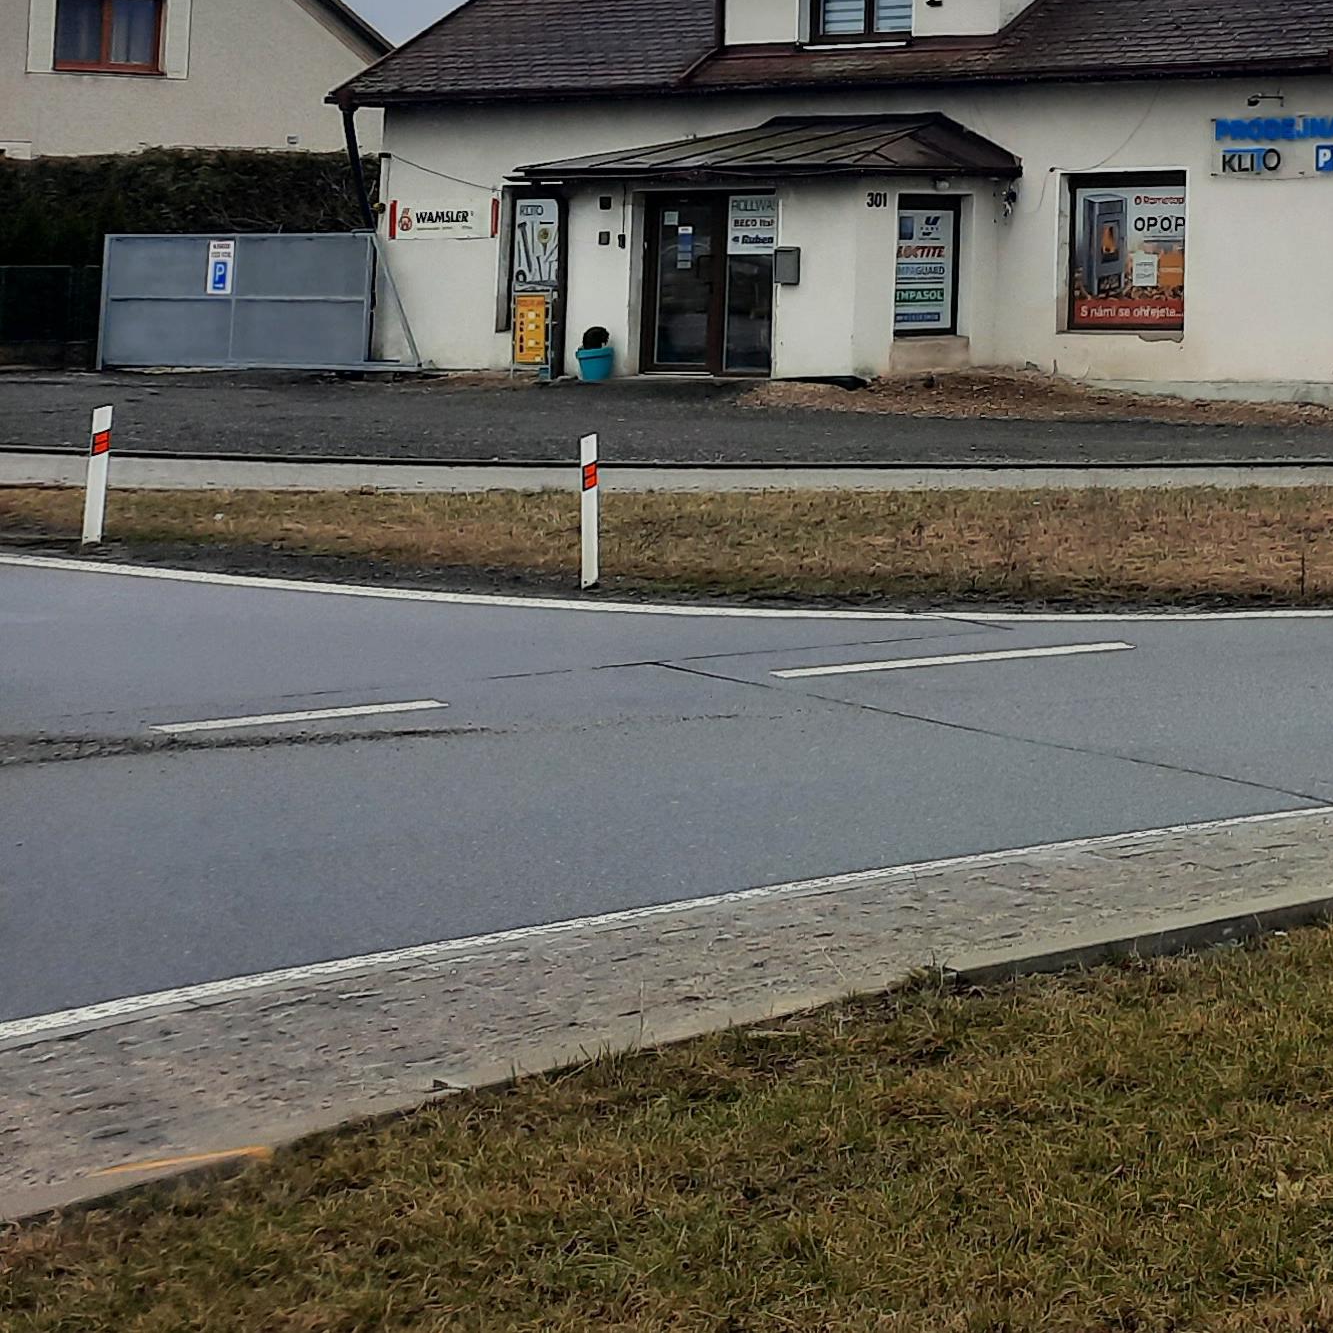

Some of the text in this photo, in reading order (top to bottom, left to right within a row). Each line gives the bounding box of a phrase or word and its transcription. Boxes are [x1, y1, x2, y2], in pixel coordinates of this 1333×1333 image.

[1222, 147, 1281, 173] KLITO
[1318, 148, 1332, 168] P
[866, 192, 887, 208] 301
[416, 210, 469, 224] WAMSLER
[1134, 216, 1185, 232] OPOP
[1080, 305, 1089, 317] S
[1090, 305, 1117, 317] námi
[1119, 308, 1131, 317] se
